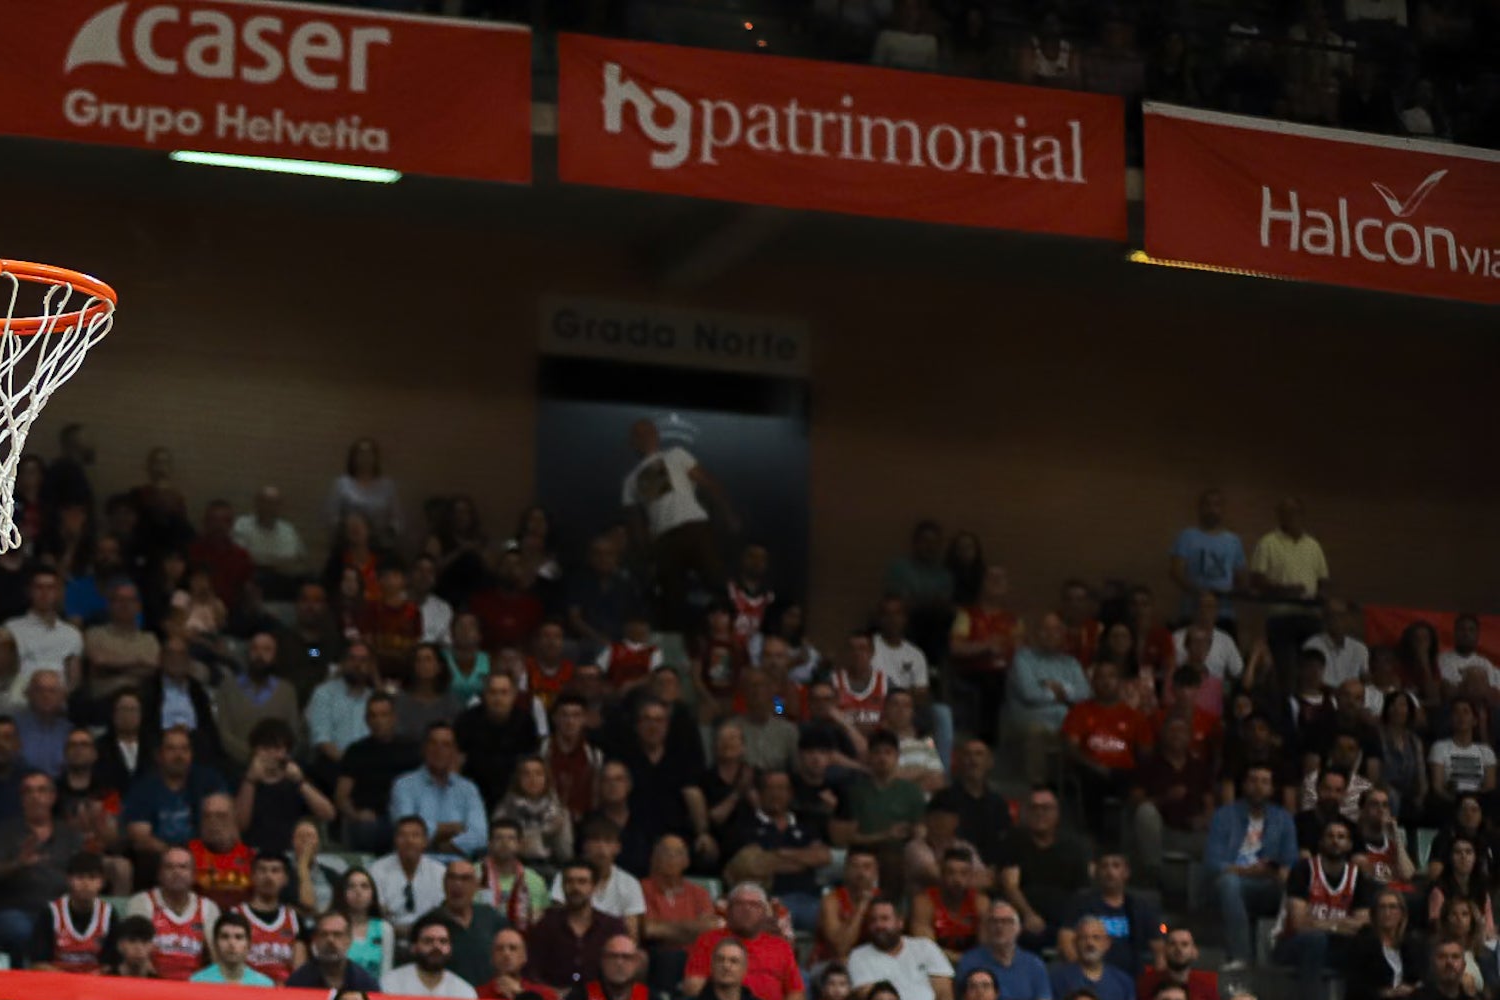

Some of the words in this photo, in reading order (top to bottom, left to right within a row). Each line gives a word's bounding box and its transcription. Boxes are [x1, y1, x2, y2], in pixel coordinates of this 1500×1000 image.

[132, 4, 392, 93] caser
[63, 89, 204, 142] Grupo
[215, 103, 390, 154] Helvetia
[552, 310, 675, 350] Grada
[692, 323, 797, 361] Norte
